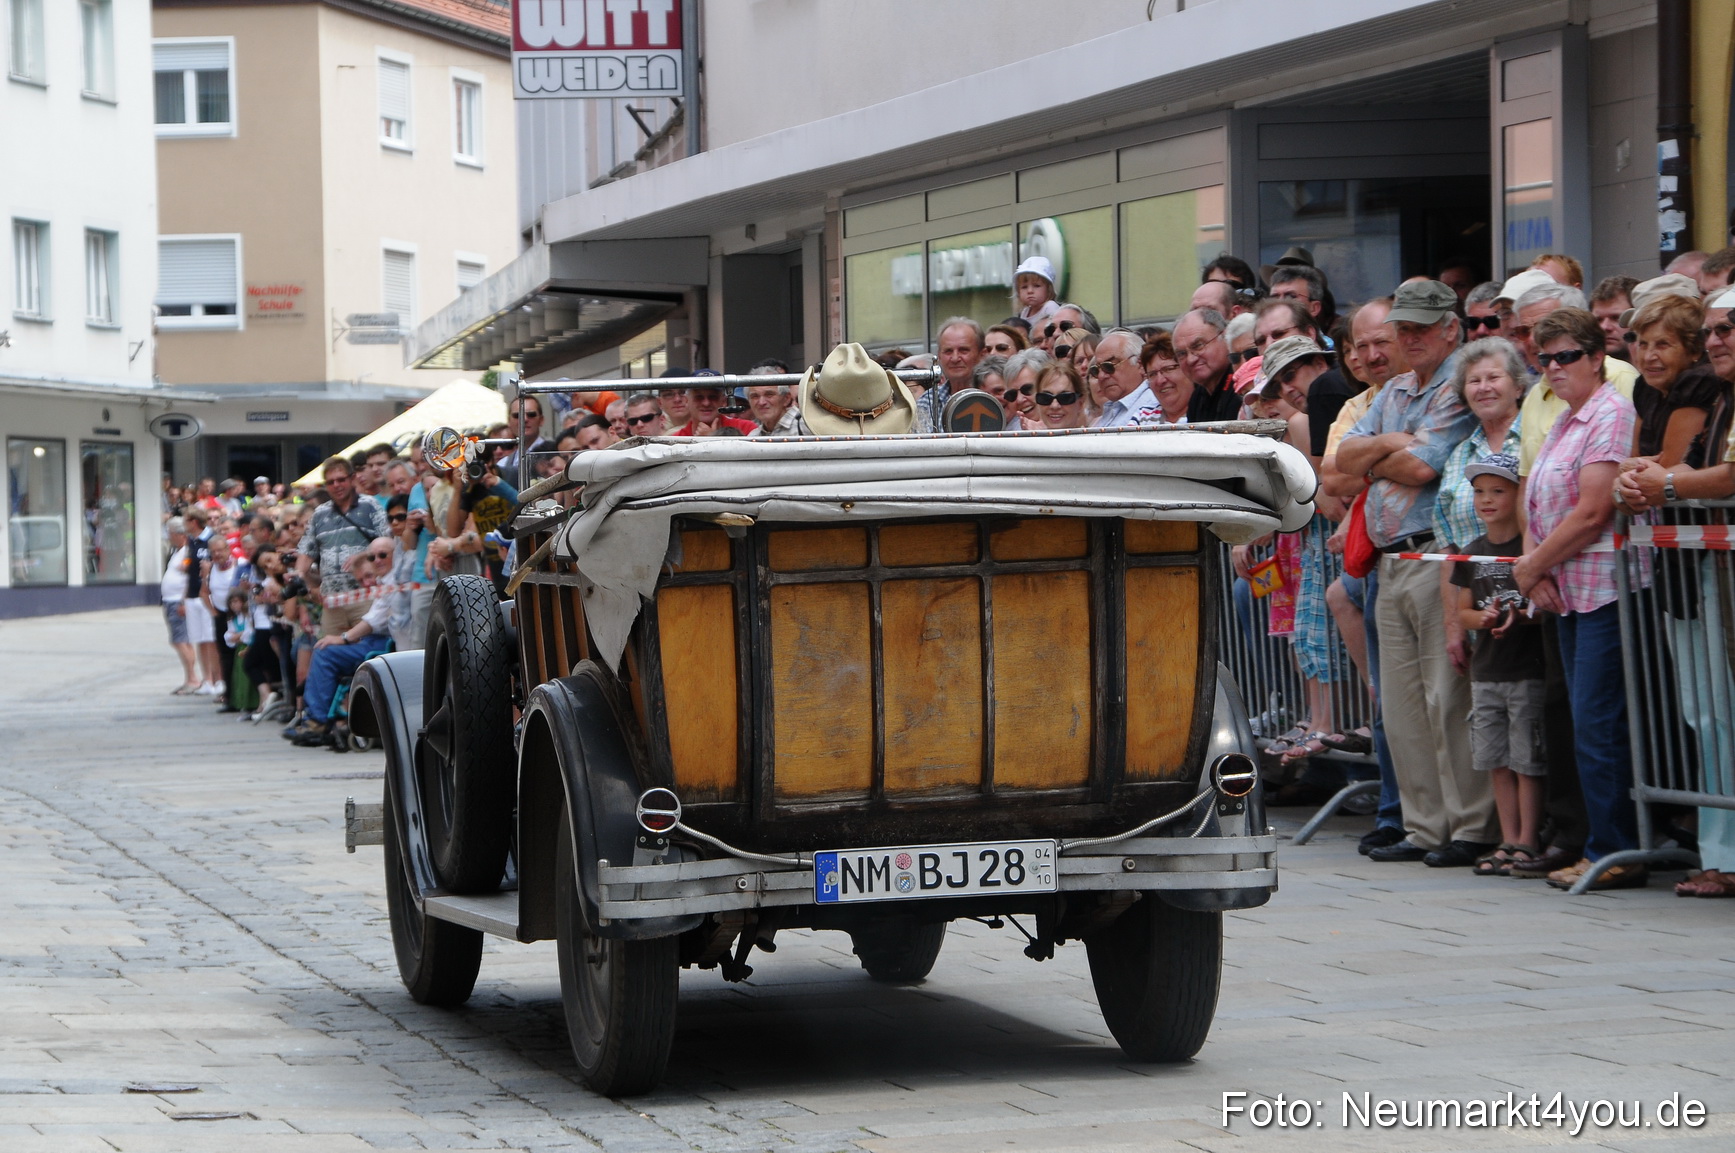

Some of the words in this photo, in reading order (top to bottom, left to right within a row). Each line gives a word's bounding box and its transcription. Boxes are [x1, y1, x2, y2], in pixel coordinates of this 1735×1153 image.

[518, 0, 674, 48] WITT
[518, 54, 678, 94] WEIDEN
[258, 299, 294, 311] Schule
[1034, 848, 1050, 859] 04
[841, 855, 891, 894] NM
[1036, 873, 1051, 885] 10
